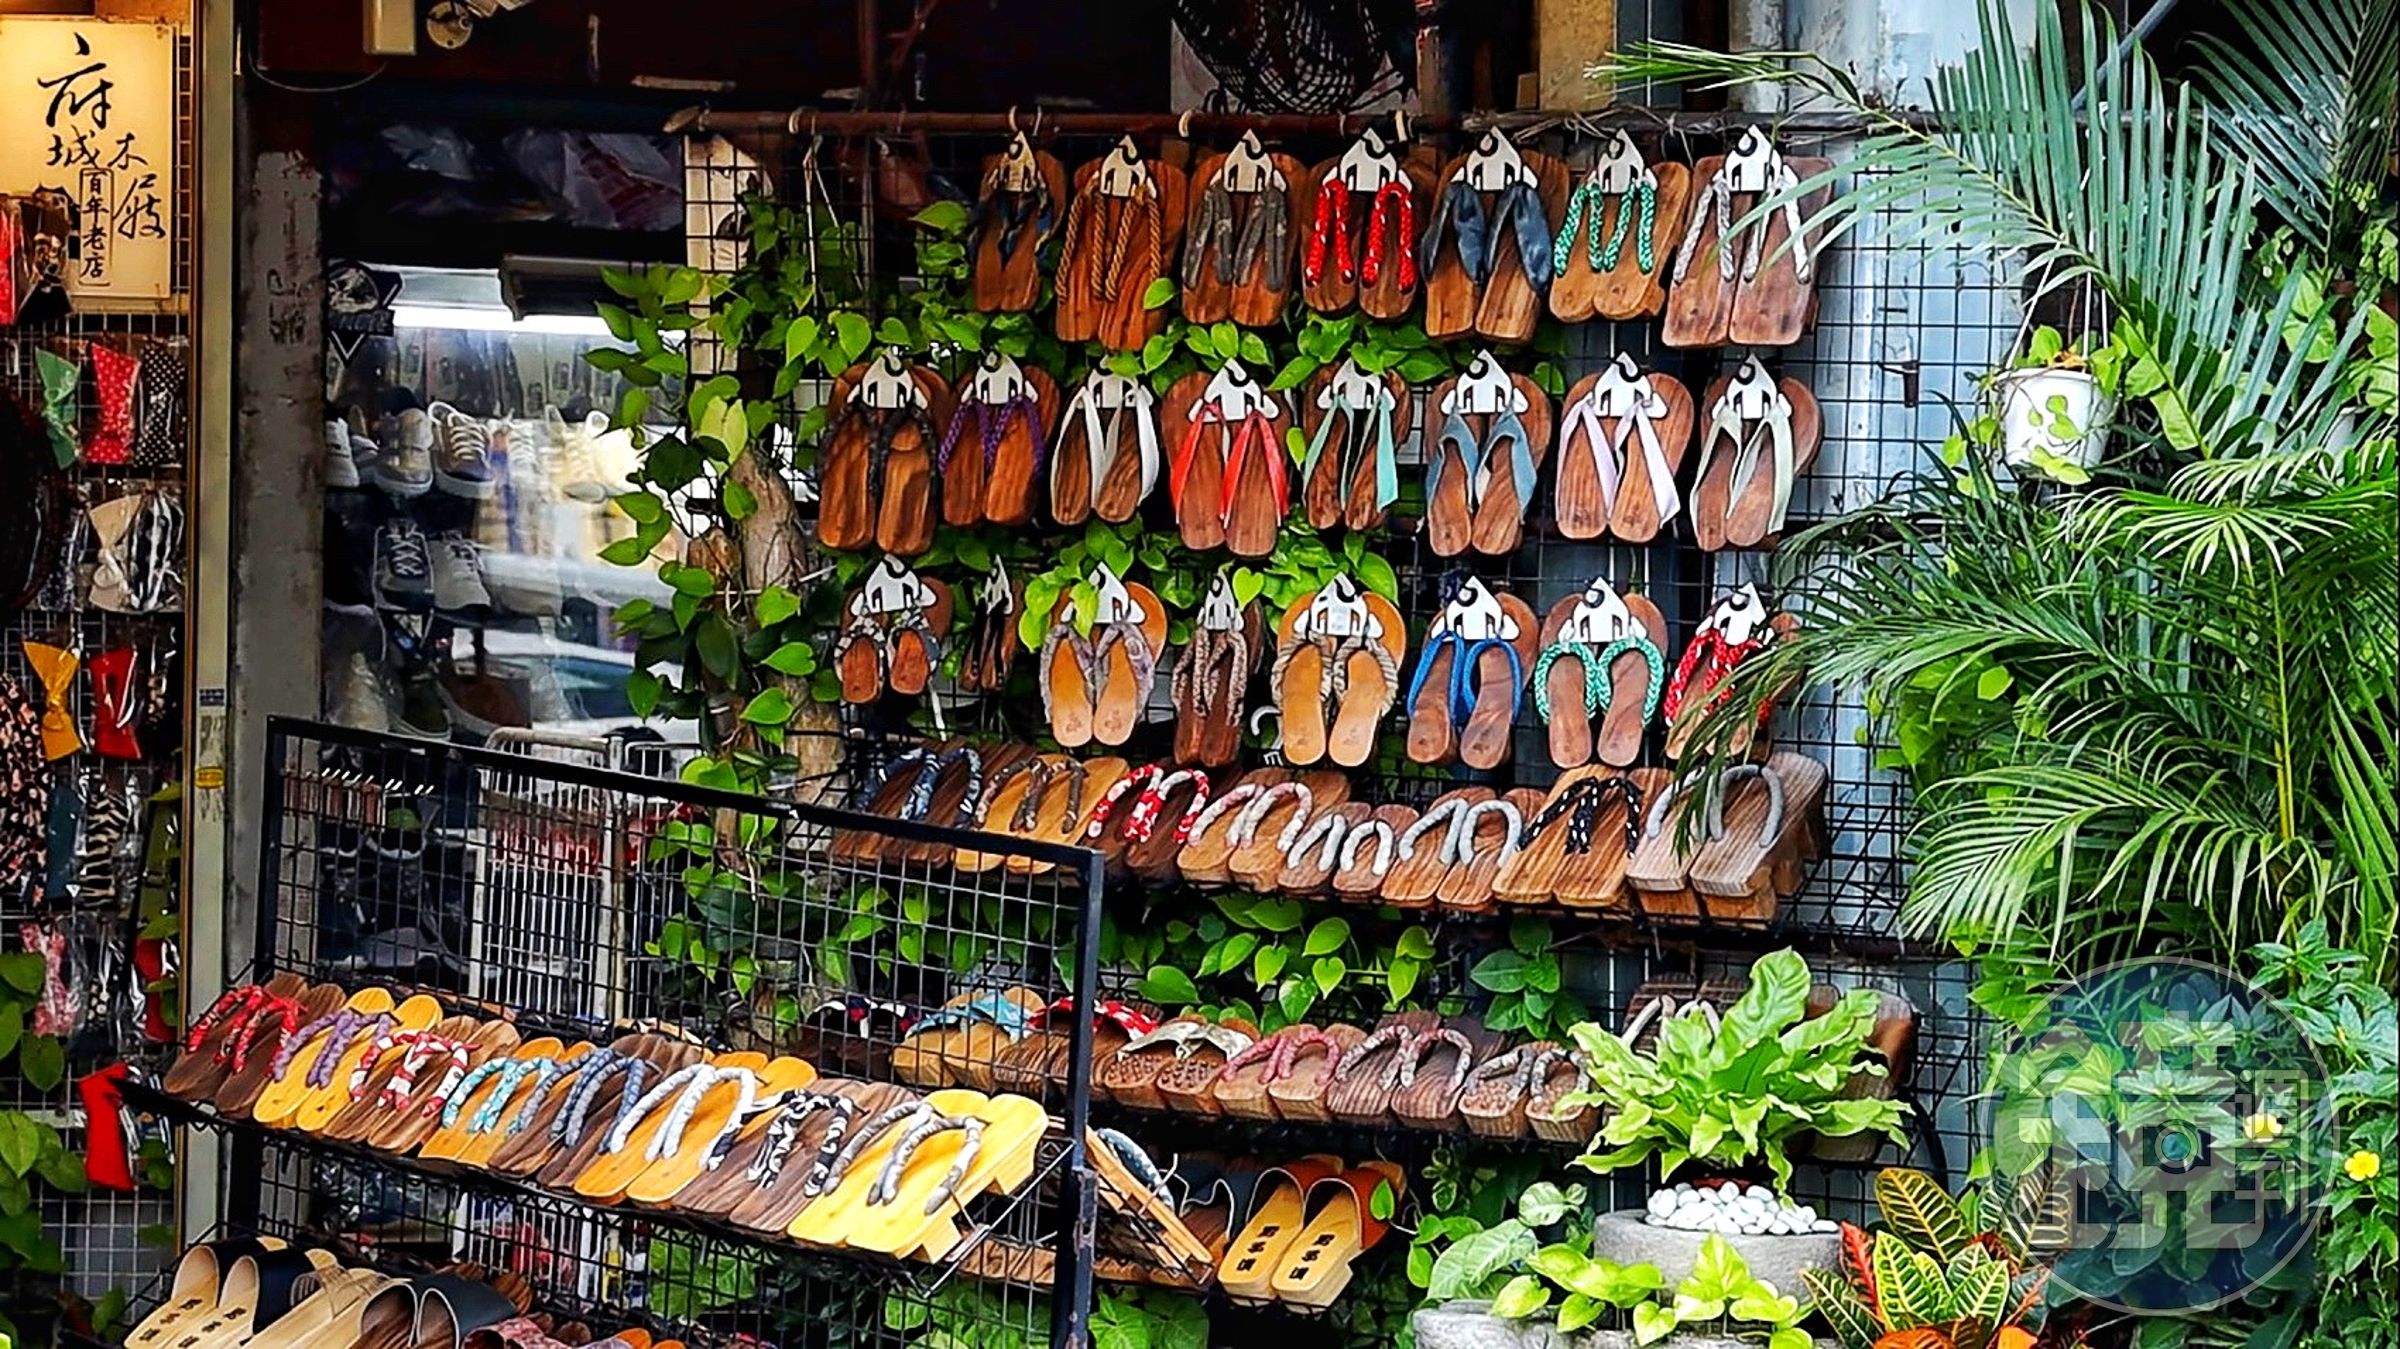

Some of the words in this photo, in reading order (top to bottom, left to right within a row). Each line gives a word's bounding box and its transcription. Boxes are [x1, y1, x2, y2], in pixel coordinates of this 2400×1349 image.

[37, 32, 114, 169] 府城
[80, 171, 110, 279] 百年老店
